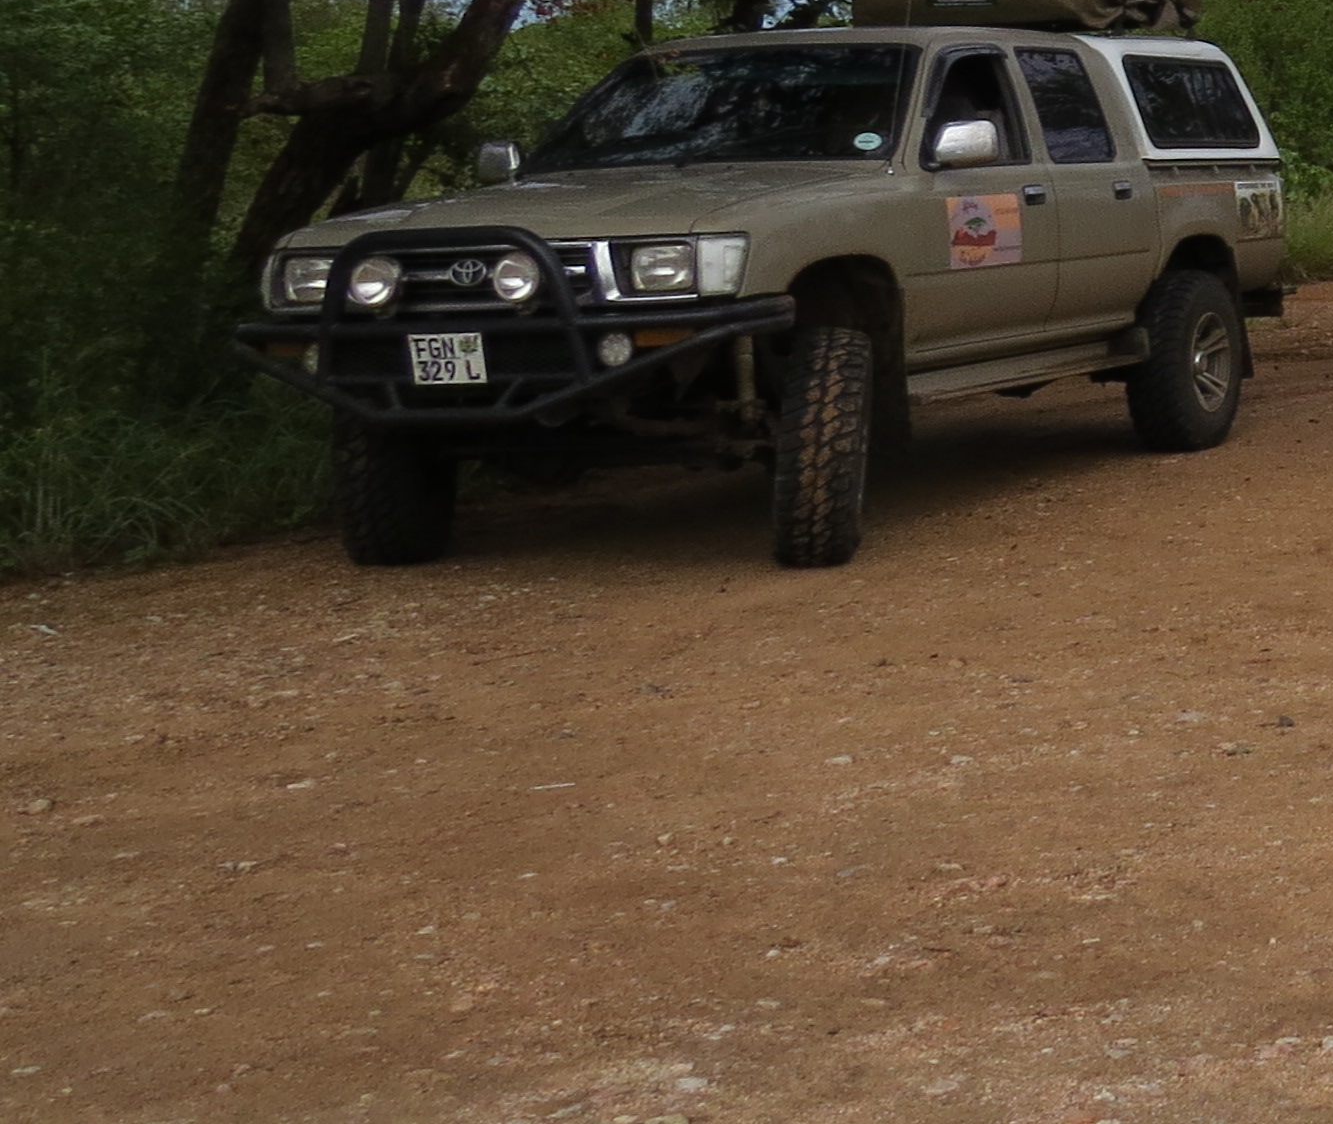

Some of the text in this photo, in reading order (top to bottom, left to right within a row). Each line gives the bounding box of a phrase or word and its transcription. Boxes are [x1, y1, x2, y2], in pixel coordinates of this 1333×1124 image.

[413, 337, 456, 359] FGN
[417, 359, 480, 381] 329 L
